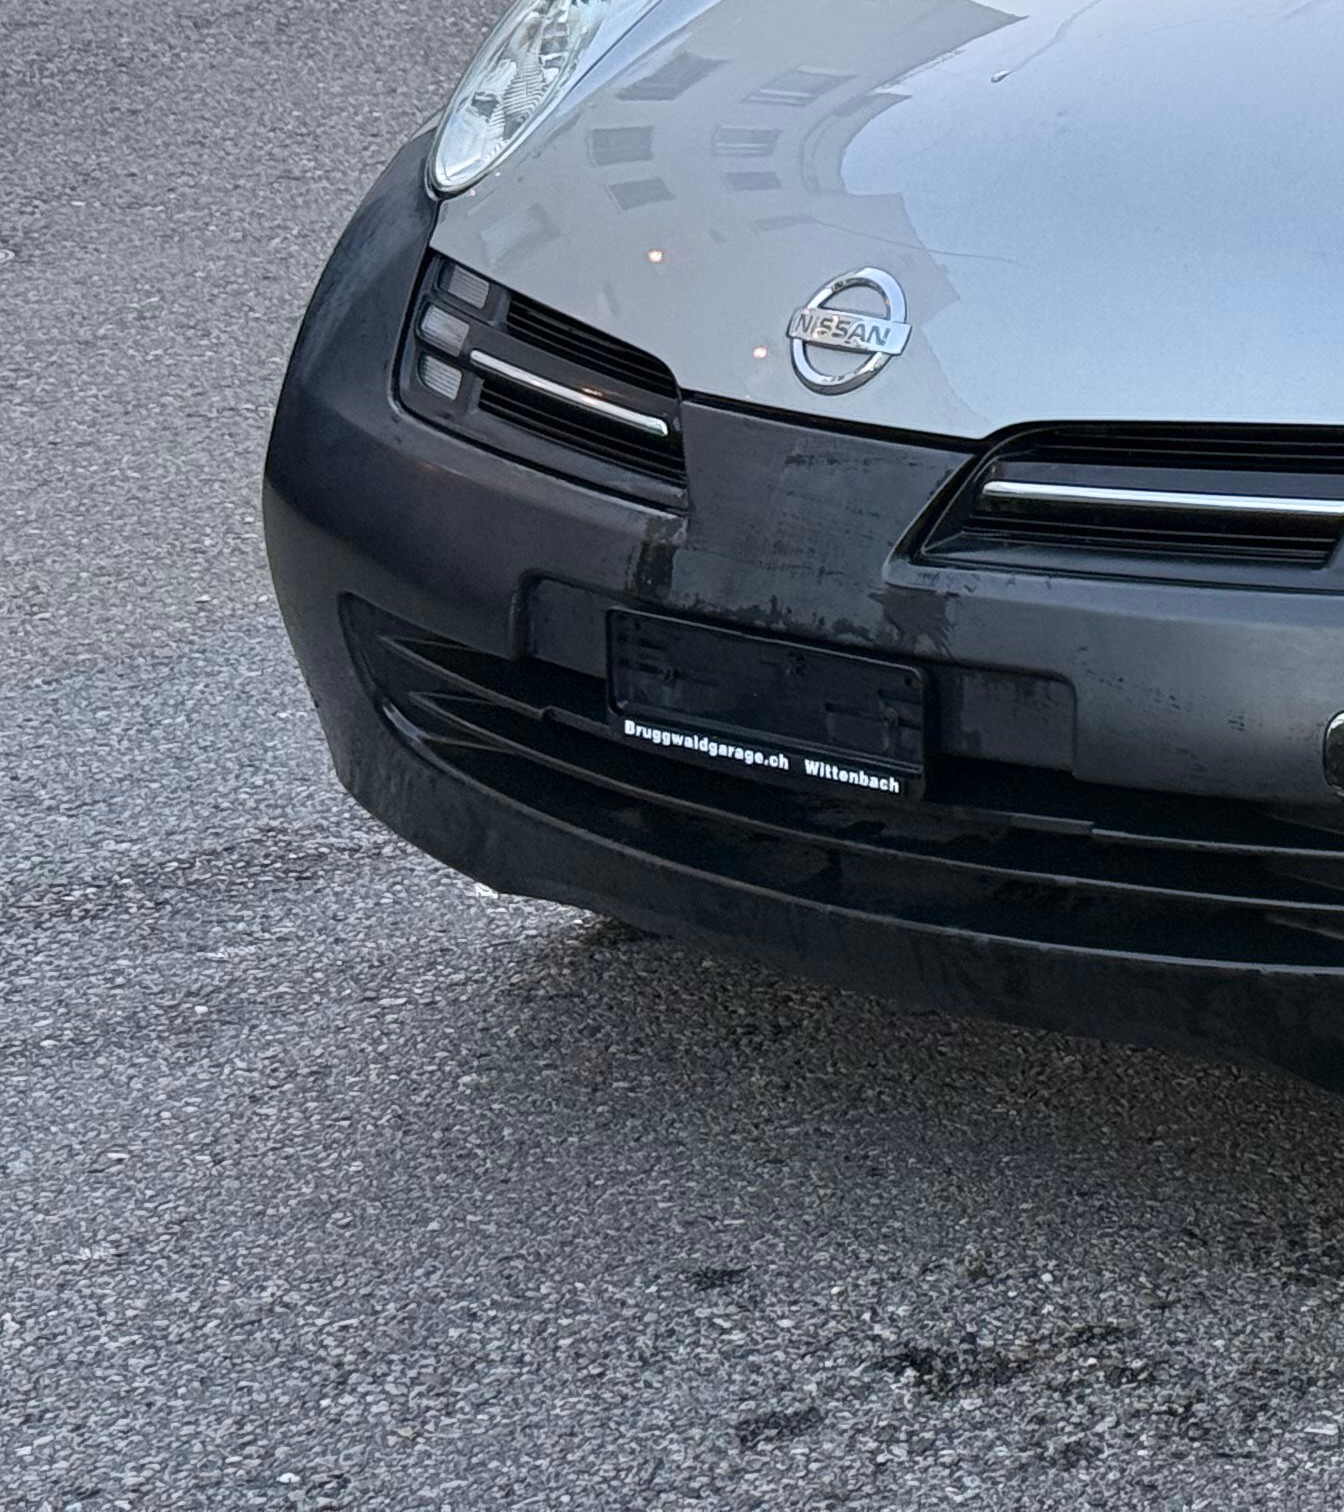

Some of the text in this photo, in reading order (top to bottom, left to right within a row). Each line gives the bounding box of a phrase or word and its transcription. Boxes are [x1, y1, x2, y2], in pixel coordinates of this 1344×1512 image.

[794, 314, 891, 346] NISSAN
[624, 719, 900, 794] Bruggwaldgarage.ch Wittenbach
